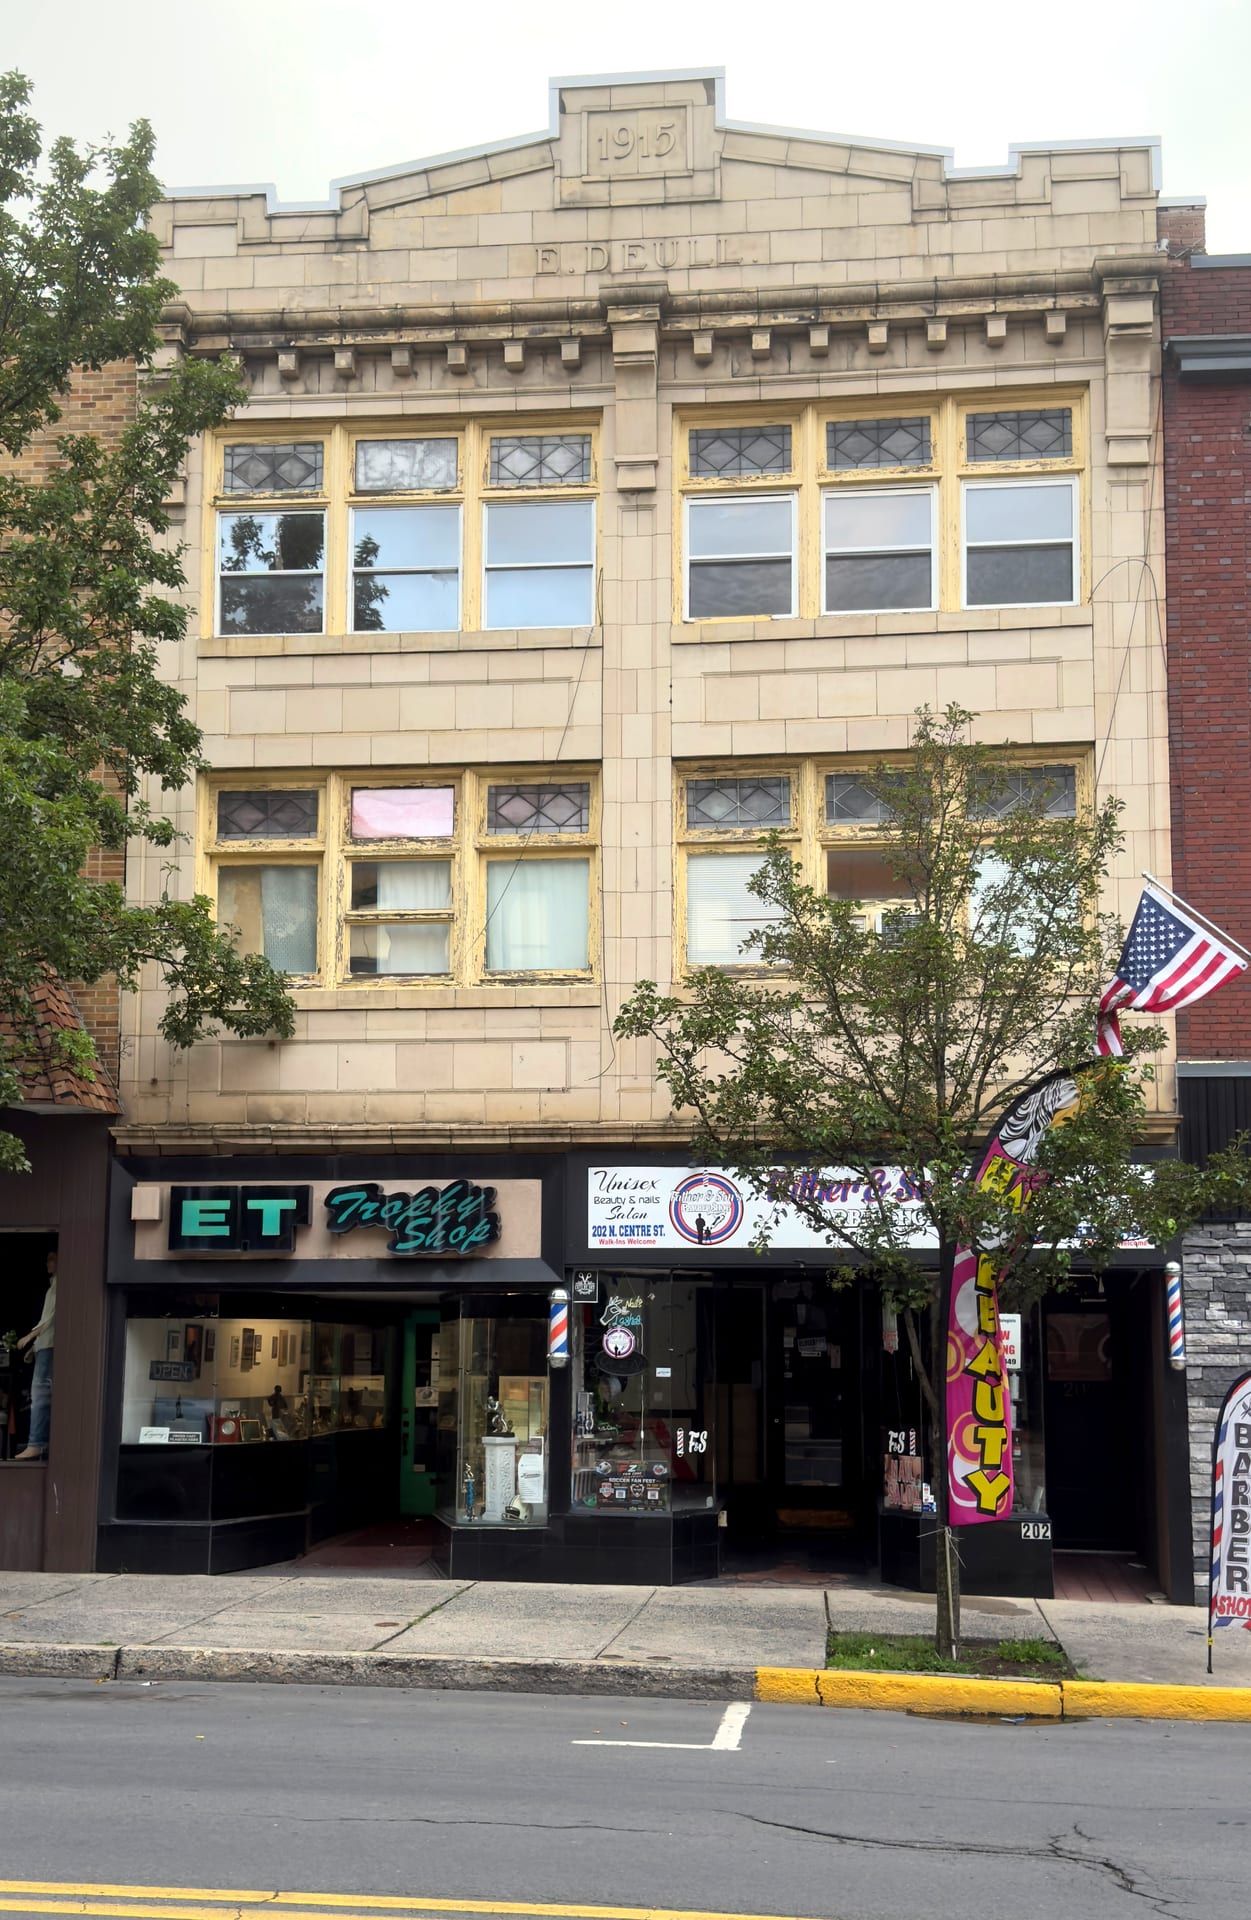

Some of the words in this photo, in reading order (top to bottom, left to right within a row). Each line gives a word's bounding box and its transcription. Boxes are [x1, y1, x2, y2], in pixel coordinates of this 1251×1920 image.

[598, 122, 676, 160] 1915
[594, 1170, 661, 1193] Unisex
[331, 1184, 486, 1226] Trophy
[594, 1196, 626, 1205] Beauty
[629, 1196, 636, 1204] &
[639, 1196, 661, 1204] nails
[182, 1199, 297, 1236] ET
[605, 1205, 647, 1220] Salon
[396, 1216, 491, 1252] Shop
[592, 1225, 607, 1237] 202
[609, 1225, 617, 1237] N.
[619, 1225, 651, 1237] CENTRE
[653, 1225, 666, 1237] ST.
[153, 1364, 190, 1378] OPEN
[1226, 1422, 1251, 1593] BARBER
[1022, 1523, 1049, 1539] 202
